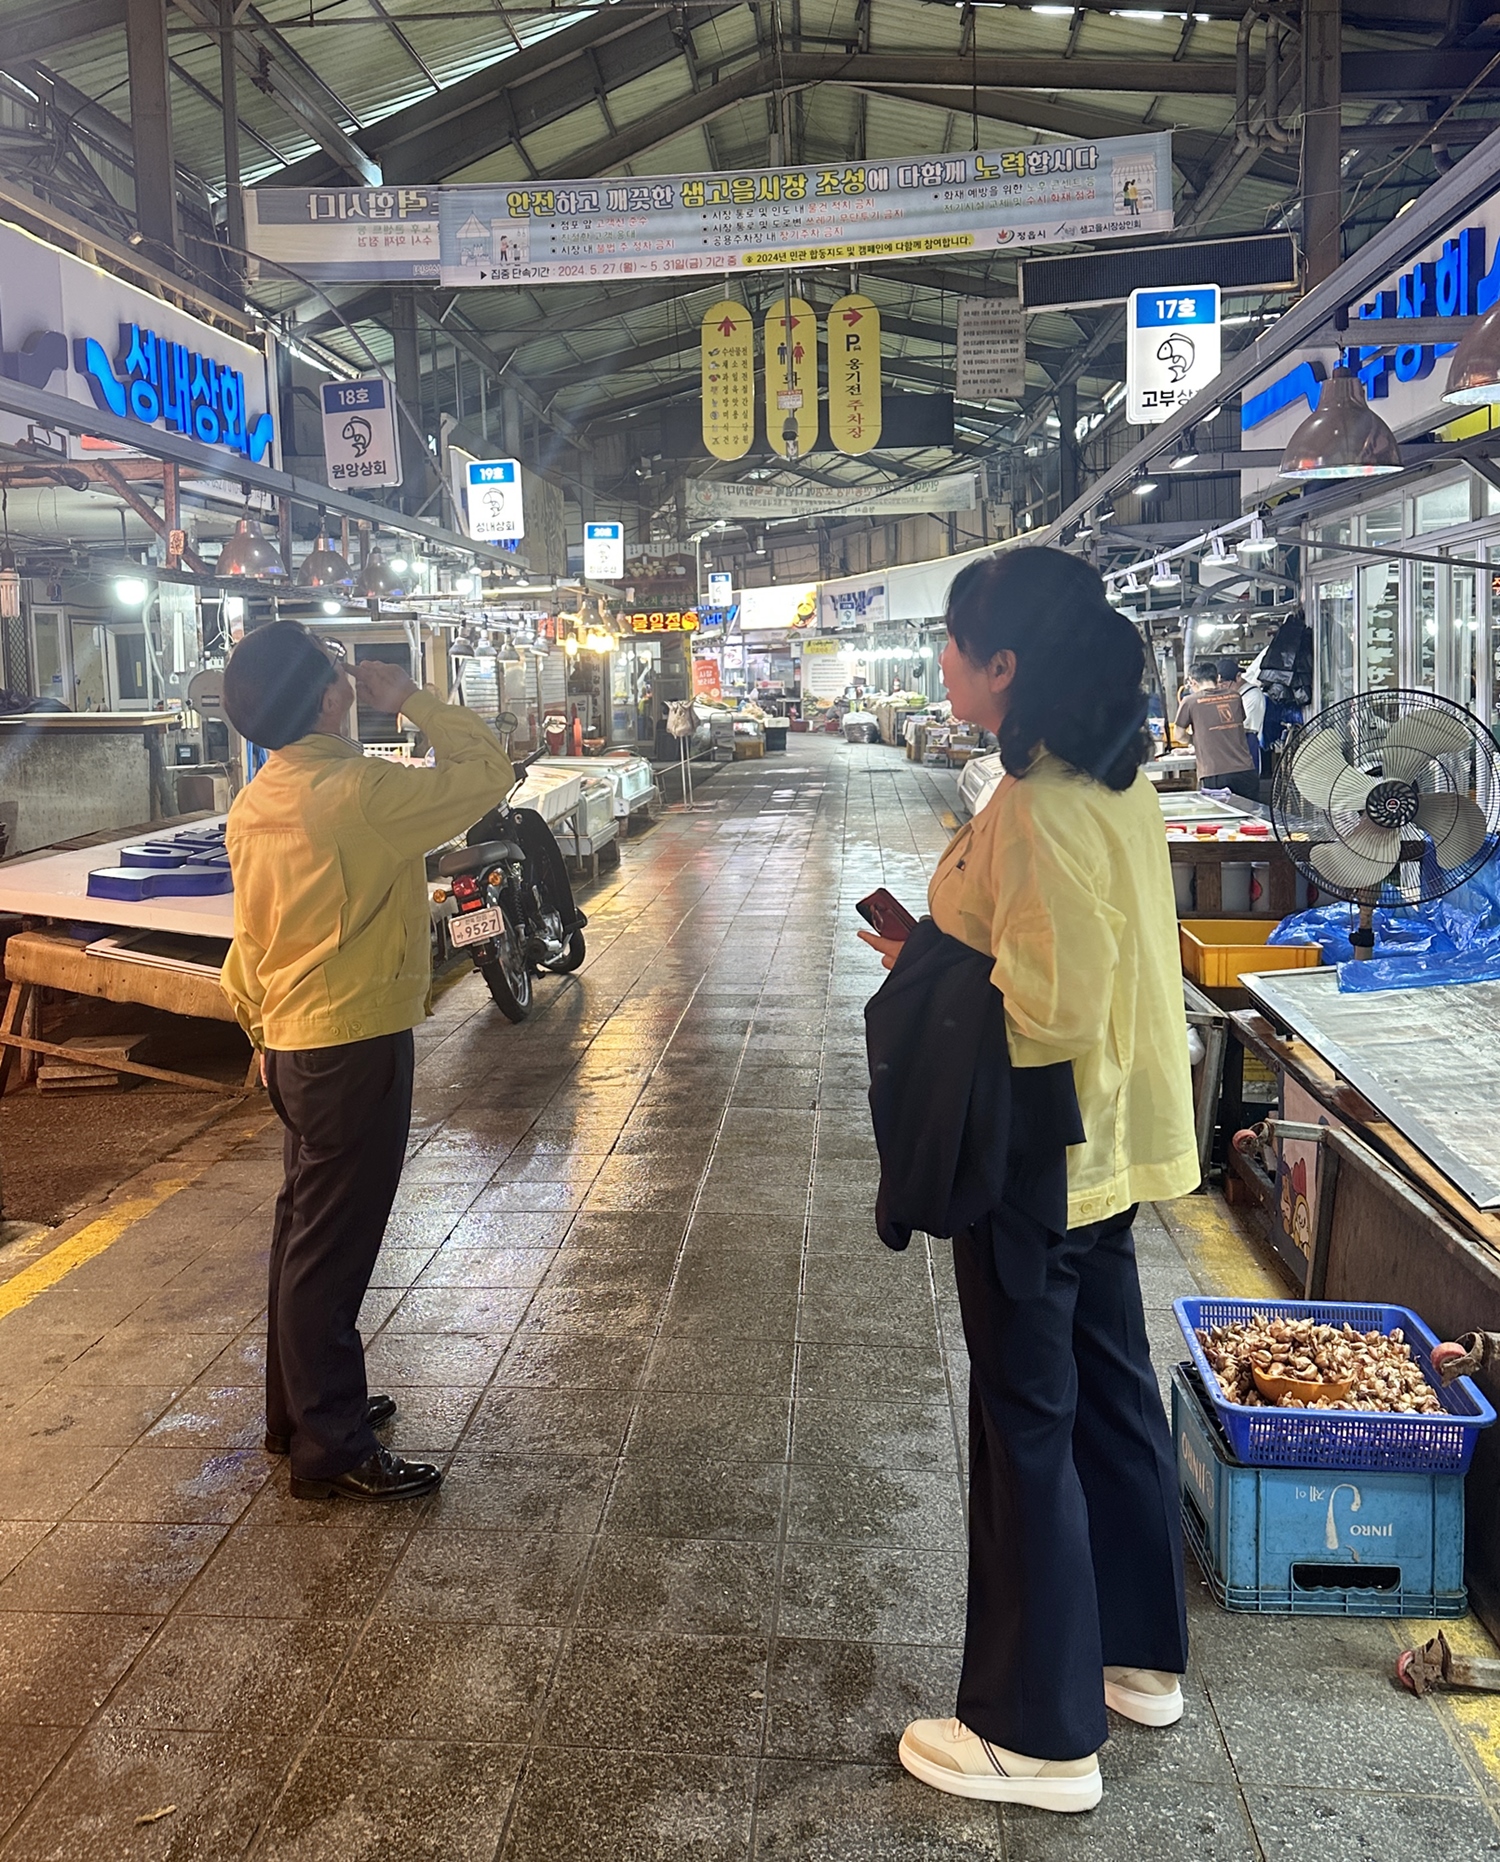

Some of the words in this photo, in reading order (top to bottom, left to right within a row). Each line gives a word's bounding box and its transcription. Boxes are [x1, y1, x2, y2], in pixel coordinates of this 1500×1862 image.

[507, 190, 600, 218] 안전하고
[607, 184, 675, 212] 깨끗한
[681, 174, 808, 208] 샘고을시장
[816, 167, 889, 196] 조성에
[898, 160, 966, 188] 다함께
[975, 146, 1099, 181] 노력합시다
[944, 190, 965, 201] 화재
[967, 187, 999, 198] 예방을
[1002, 184, 1023, 195] 위한
[1027, 182, 1046, 193] 노후
[1050, 178, 1082, 190] 콘센트
[1086, 176, 1096, 187] 등
[712, 210, 731, 221] 시장
[735, 208, 755, 219] 통로
[759, 207, 768, 218] 및
[772, 205, 791, 217] 인도
[794, 204, 805, 214] 내
[808, 202, 827, 214] 물건
[831, 200, 851, 211] 적치
[855, 198, 875, 209] 금지
[713, 222, 731, 233] 시장
[735, 220, 755, 232] 통로
[759, 219, 768, 230] 및
[772, 217, 802, 230] 도로변
[806, 214, 836, 226] 쓰레기
[840, 211, 880, 223] 무단투기
[884, 209, 904, 220] 금지
[1079, 219, 1142, 235] 샘고을시장상인회
[713, 232, 763, 247] 공용주차장
[766, 231, 776, 242] 내
[779, 228, 820, 242] 장기주차
[824, 226, 844, 237] 금지
[1016, 229, 1046, 241] 정읍시
[756, 252, 787, 263] 2024년
[789, 249, 807, 261] 민관
[809, 247, 844, 260] 합동지도
[847, 246, 856, 257] 및
[858, 243, 893, 256] 캠페인에
[896, 240, 922, 252] 다함께
[924, 236, 971, 250] 참여합니다.
[491, 269, 510, 280] 집중
[512, 267, 550, 279] 단속기간
[558, 265, 588, 277] 2024.
[706, 255, 725, 267] 기간
[727, 255, 737, 266] 중
[1156, 297, 1197, 319] 17호
[846, 334, 861, 352] P
[845, 358, 864, 396] 옹기전
[120, 323, 247, 458] 성내상회
[338, 388, 369, 406] 18호
[1141, 388, 1200, 408] 고부상
[846, 399, 865, 439] 주차장
[332, 460, 387, 478] 원앙상회
[479, 467, 504, 481] 19호
[476, 521, 515, 533] 성내상회
[465, 919, 496, 938] 9527
[1181, 1432, 1206, 1494] JINRO
[1350, 1524, 1394, 1538] JINRO
